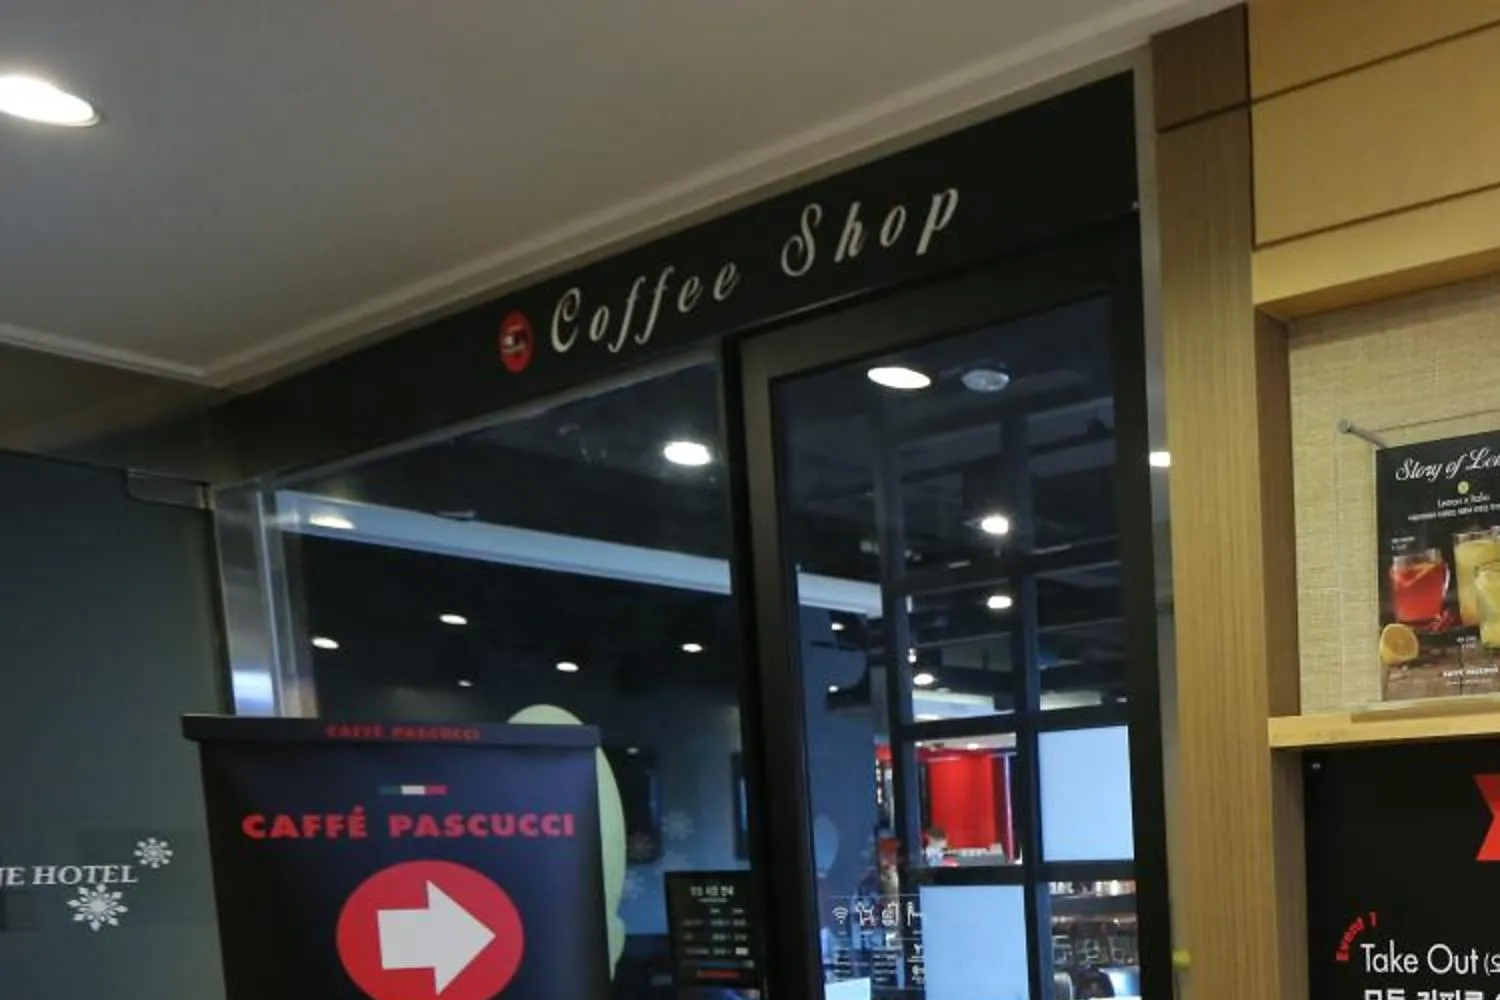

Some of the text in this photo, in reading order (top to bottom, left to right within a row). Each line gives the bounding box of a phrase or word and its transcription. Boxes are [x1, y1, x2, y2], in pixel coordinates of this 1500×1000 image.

[550, 187, 960, 354] Coffee Shop
[1395, 457, 1443, 484] Story
[1446, 453, 1468, 480] of
[392, 725, 481, 741] PASCUCCI
[241, 805, 576, 839] CAFFÉ PASCUCCI
[31, 864, 139, 886] HOTEL
[1368, 911, 1378, 927] 1
[1360, 938, 1419, 974] Take
[1427, 943, 1478, 975] Out
